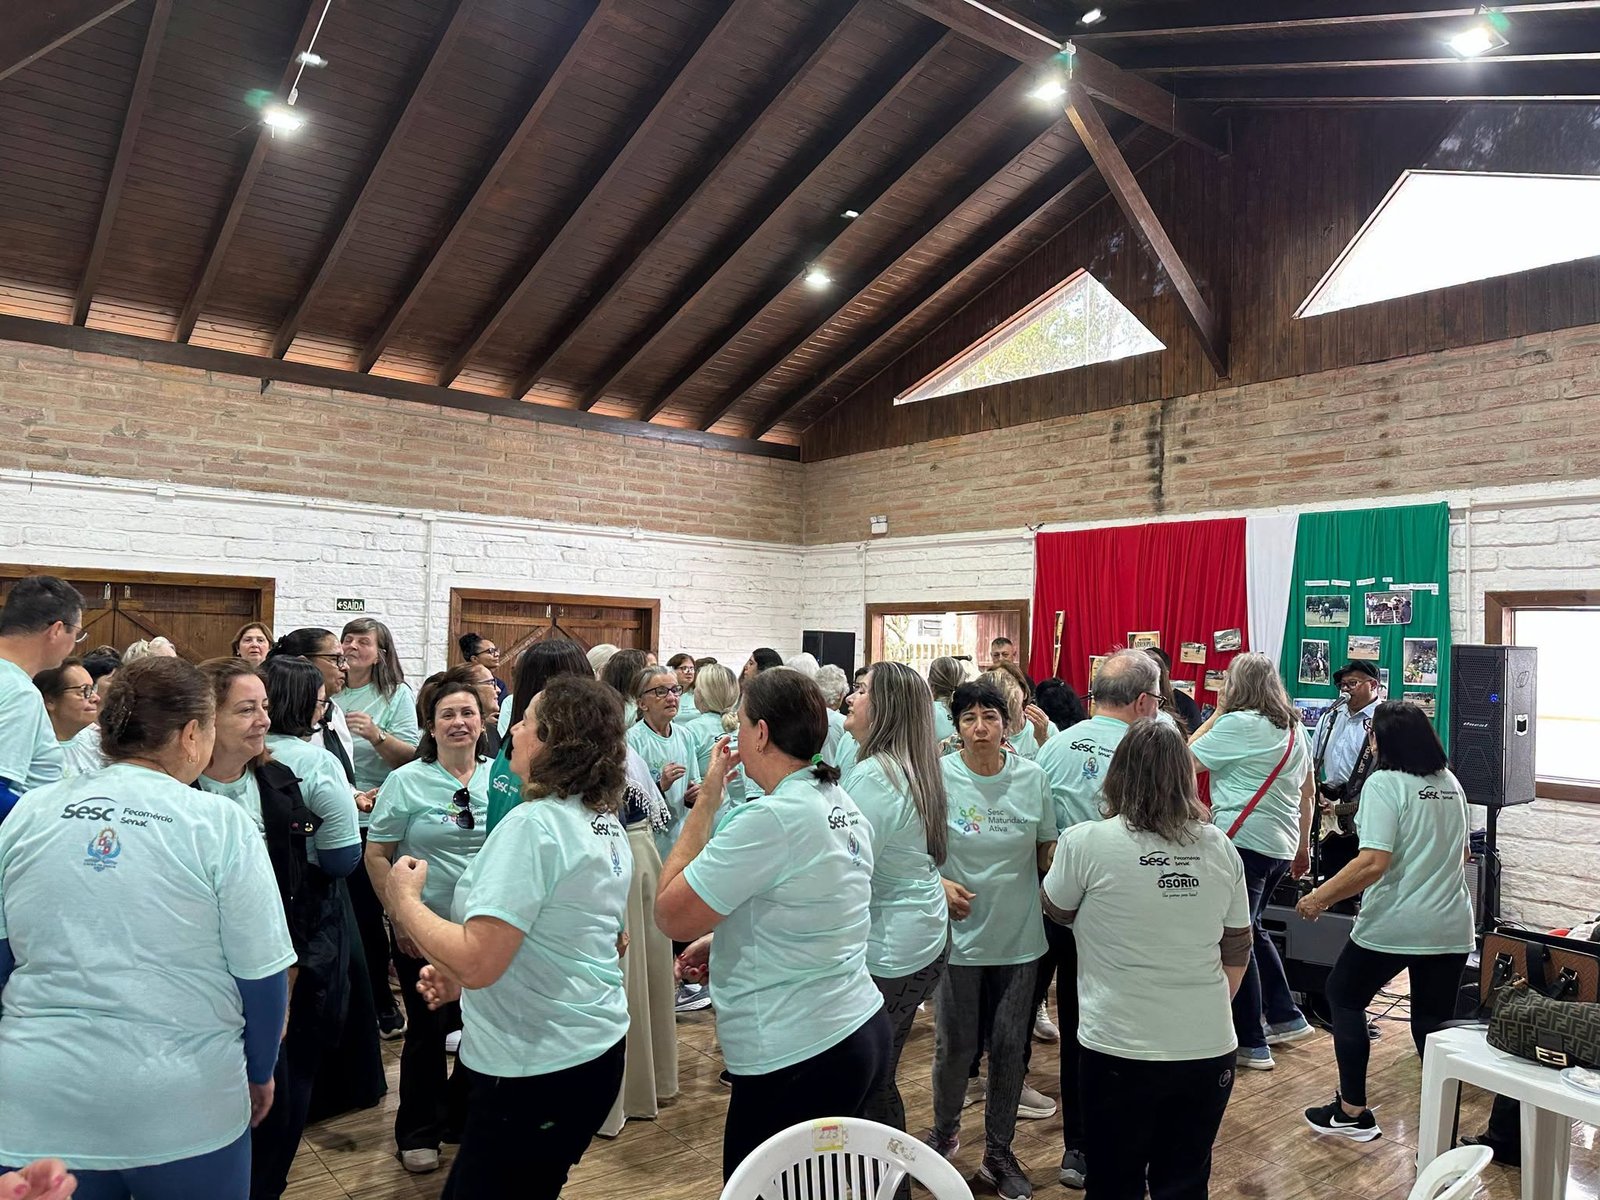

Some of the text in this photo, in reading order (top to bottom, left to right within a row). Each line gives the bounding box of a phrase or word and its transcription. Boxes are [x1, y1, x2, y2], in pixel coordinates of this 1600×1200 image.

[342, 599, 364, 611] SAÍDA
[123, 807, 173, 823] Fecomércio
[987, 808, 1004, 816] Sesc
[988, 816, 1028, 825] Maturidade
[989, 824, 1008, 832] Ativa
